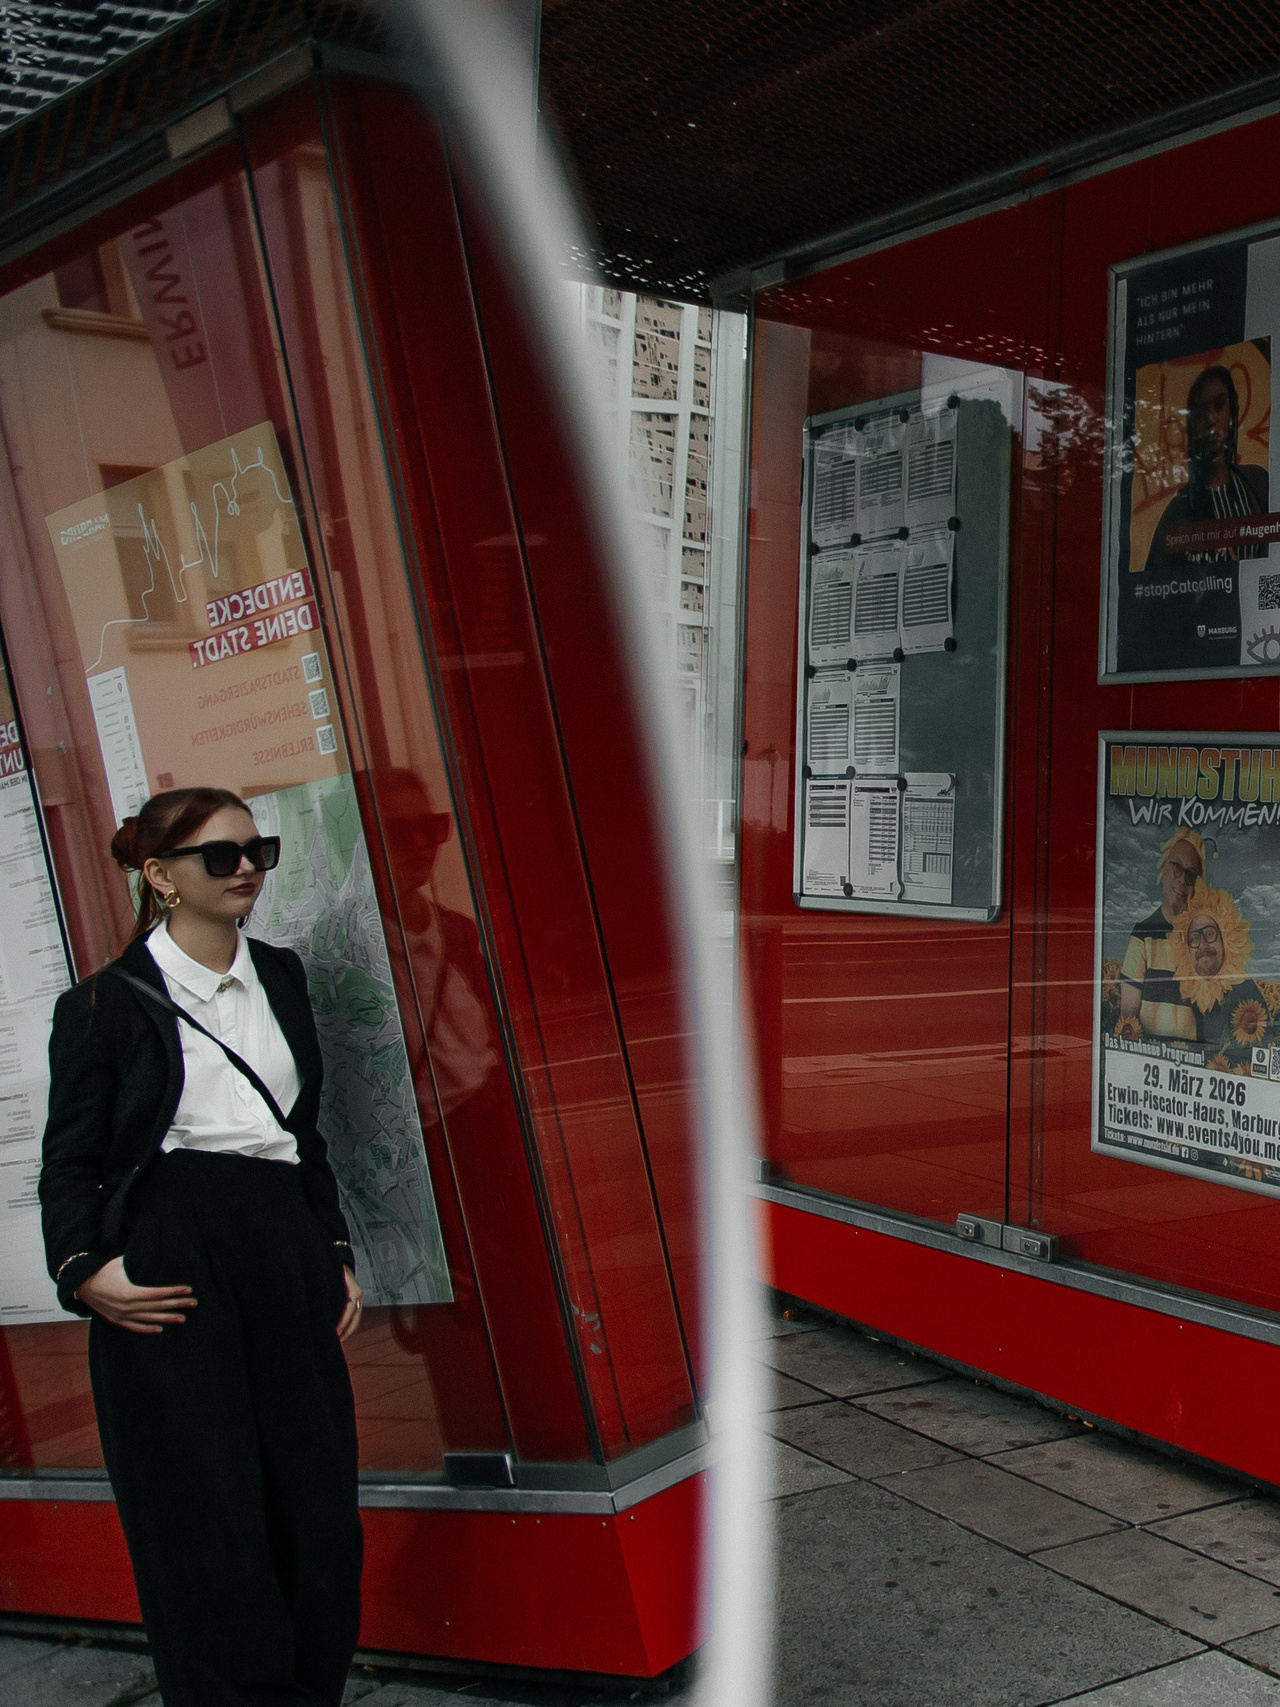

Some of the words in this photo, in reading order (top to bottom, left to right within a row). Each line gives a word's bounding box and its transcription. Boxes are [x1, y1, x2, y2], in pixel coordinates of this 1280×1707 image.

[1161, 288, 1178, 302] BIN
[1182, 278, 1214, 295] MEHR
[1136, 313, 1155, 329] ALS
[1158, 307, 1178, 322] NUR
[1182, 298, 1210, 315] MEIN
[1166, 533, 1190, 547] Sprich
[1191, 530, 1205, 543] mit
[1207, 529, 1221, 541] mir
[1223, 528, 1238, 540] auf
[1134, 575, 1233, 600] #stopCatcalling
[1208, 626, 1237, 635] MARBURG
[1128, 798, 1173, 826] WIR
[1105, 1032, 1119, 1049] Das
[1119, 1035, 1161, 1056] brandneue
[1161, 1043, 1205, 1066] Programm!
[1143, 1063, 1163, 1090] 29.
[1167, 1068, 1204, 1098] März
[1209, 1077, 1247, 1107] 2026
[1107, 1083, 1229, 1127] Erwin-Piscator-Haus,
[1107, 1103, 1153, 1130] Tickets:
